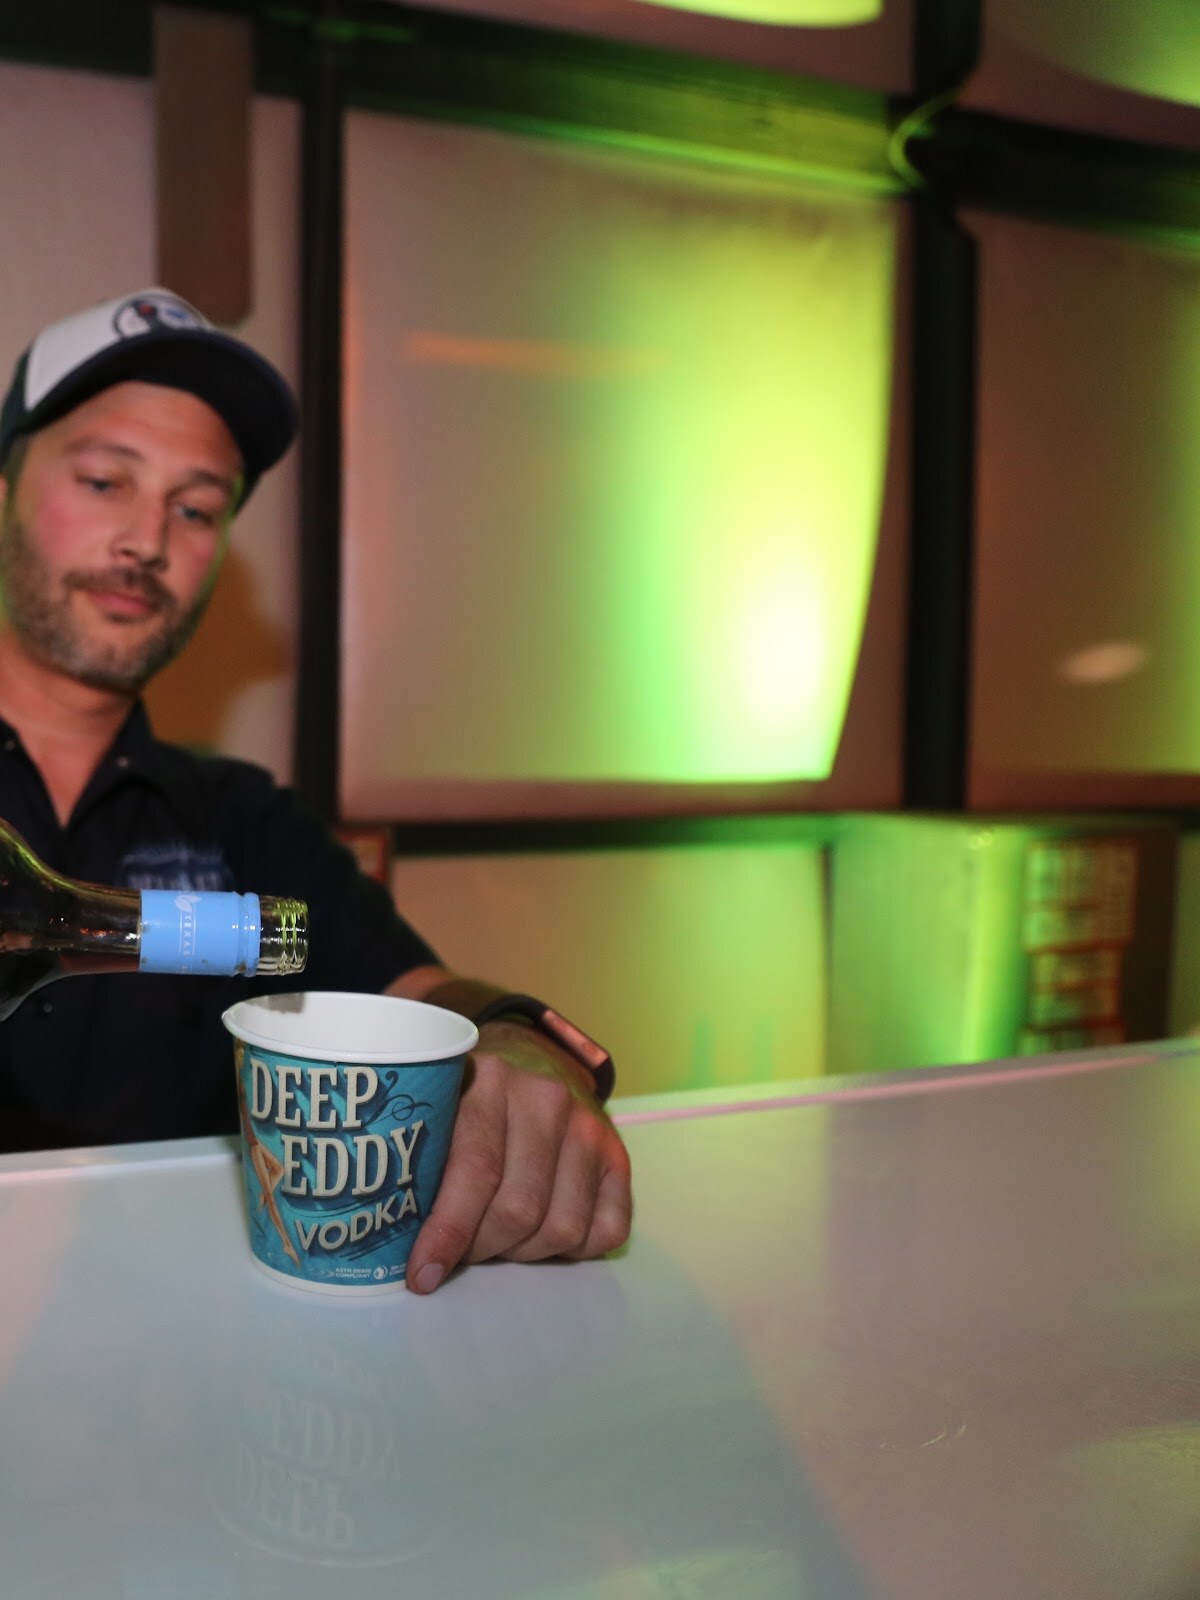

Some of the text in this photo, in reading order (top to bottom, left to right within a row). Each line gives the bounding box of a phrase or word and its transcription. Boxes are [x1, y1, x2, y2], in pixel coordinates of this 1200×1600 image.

[183, 914, 192, 956] TEXAS
[250, 1058, 379, 1129] DEEP
[280, 1119, 425, 1198] EDDY
[294, 1187, 418, 1251] VODKA
